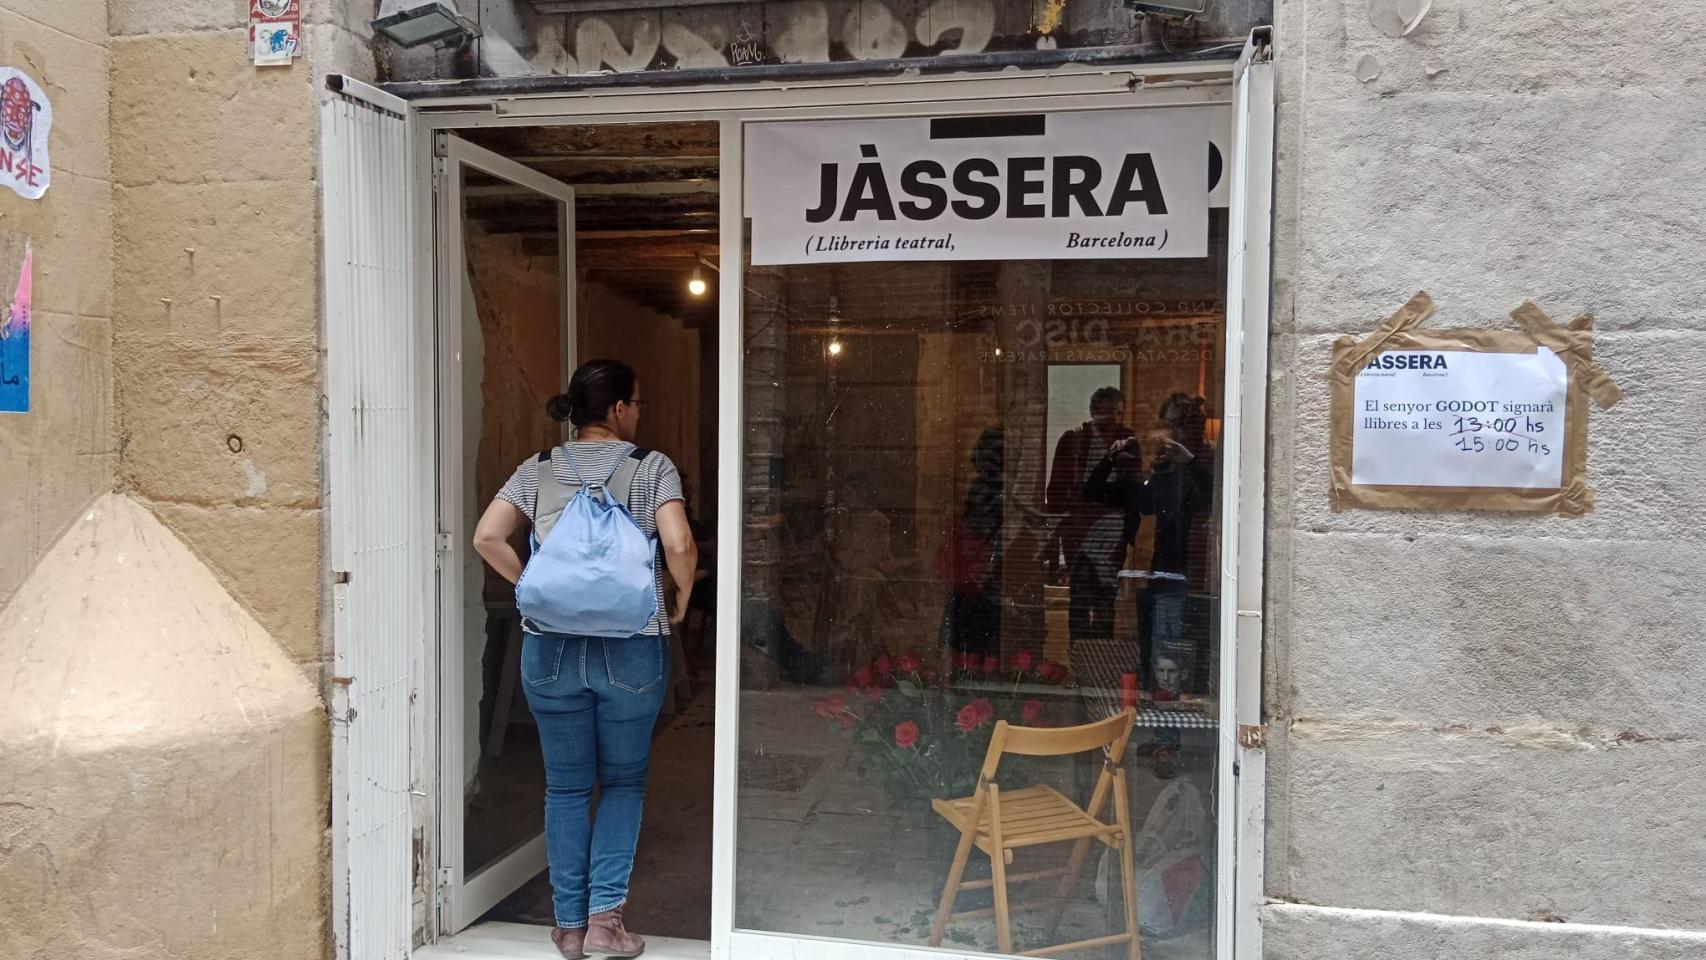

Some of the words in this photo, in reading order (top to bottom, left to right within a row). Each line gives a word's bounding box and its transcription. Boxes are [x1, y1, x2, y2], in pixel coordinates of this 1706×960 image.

[805, 143, 1169, 223] JÀSSERA
[805, 235, 890, 256] (Llibreria
[894, 234, 955, 252] teatral,
[1367, 354, 1448, 370] ASSERA
[1365, 400, 1379, 412] El
[1383, 403, 1432, 415] senyor
[1435, 401, 1499, 412] GODOT
[1502, 400, 1554, 416] signarà
[1364, 417, 1408, 430] llibres
[1411, 422, 1420, 430] a
[1424, 417, 1442, 430] les
[1526, 415, 1545, 433] hs
[1455, 437, 1519, 453] 15:00
